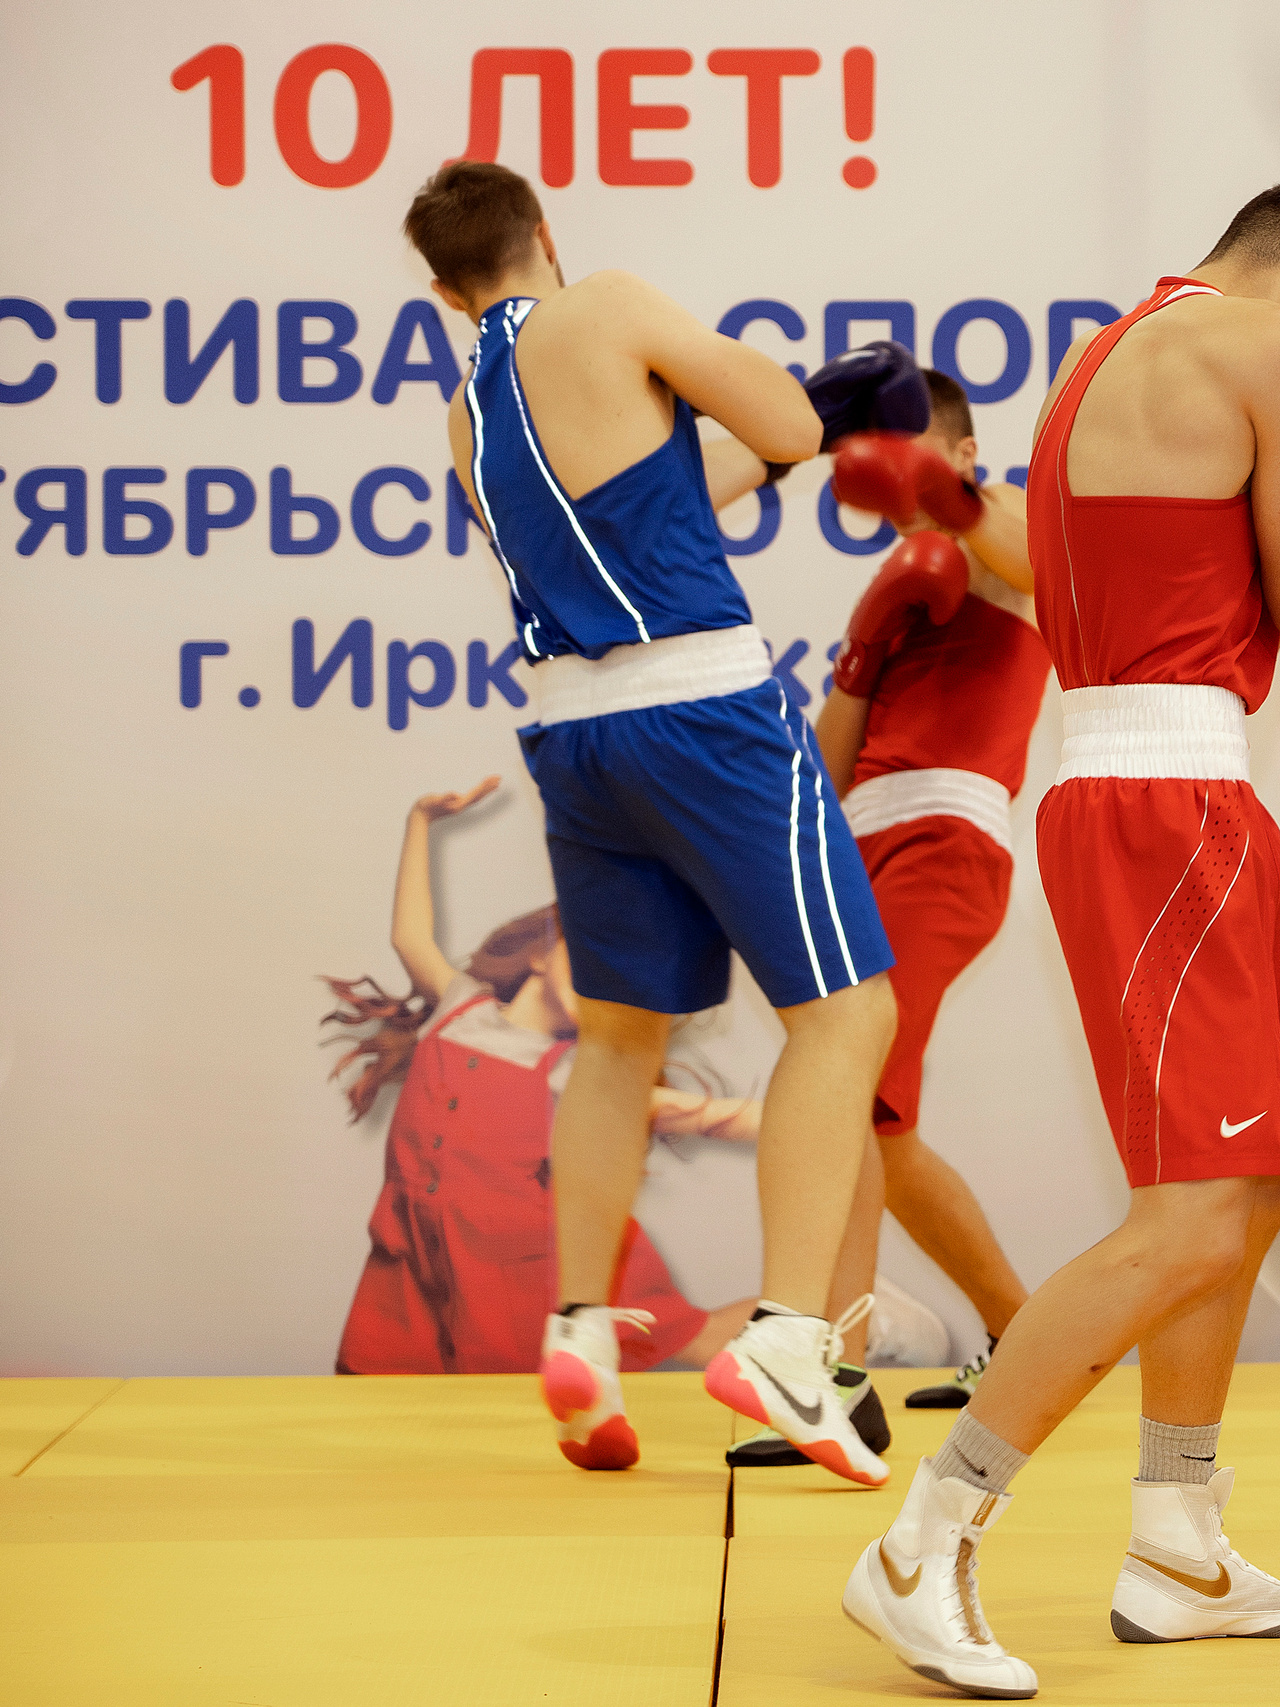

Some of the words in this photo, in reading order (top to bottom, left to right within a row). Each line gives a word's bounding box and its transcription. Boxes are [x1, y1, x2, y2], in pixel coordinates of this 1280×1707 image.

[171, 43, 393, 188] 10
[439, 46, 878, 189] ЛЕТ!
[0, 297, 463, 405] СТИВА
[179, 639, 261, 709] г.
